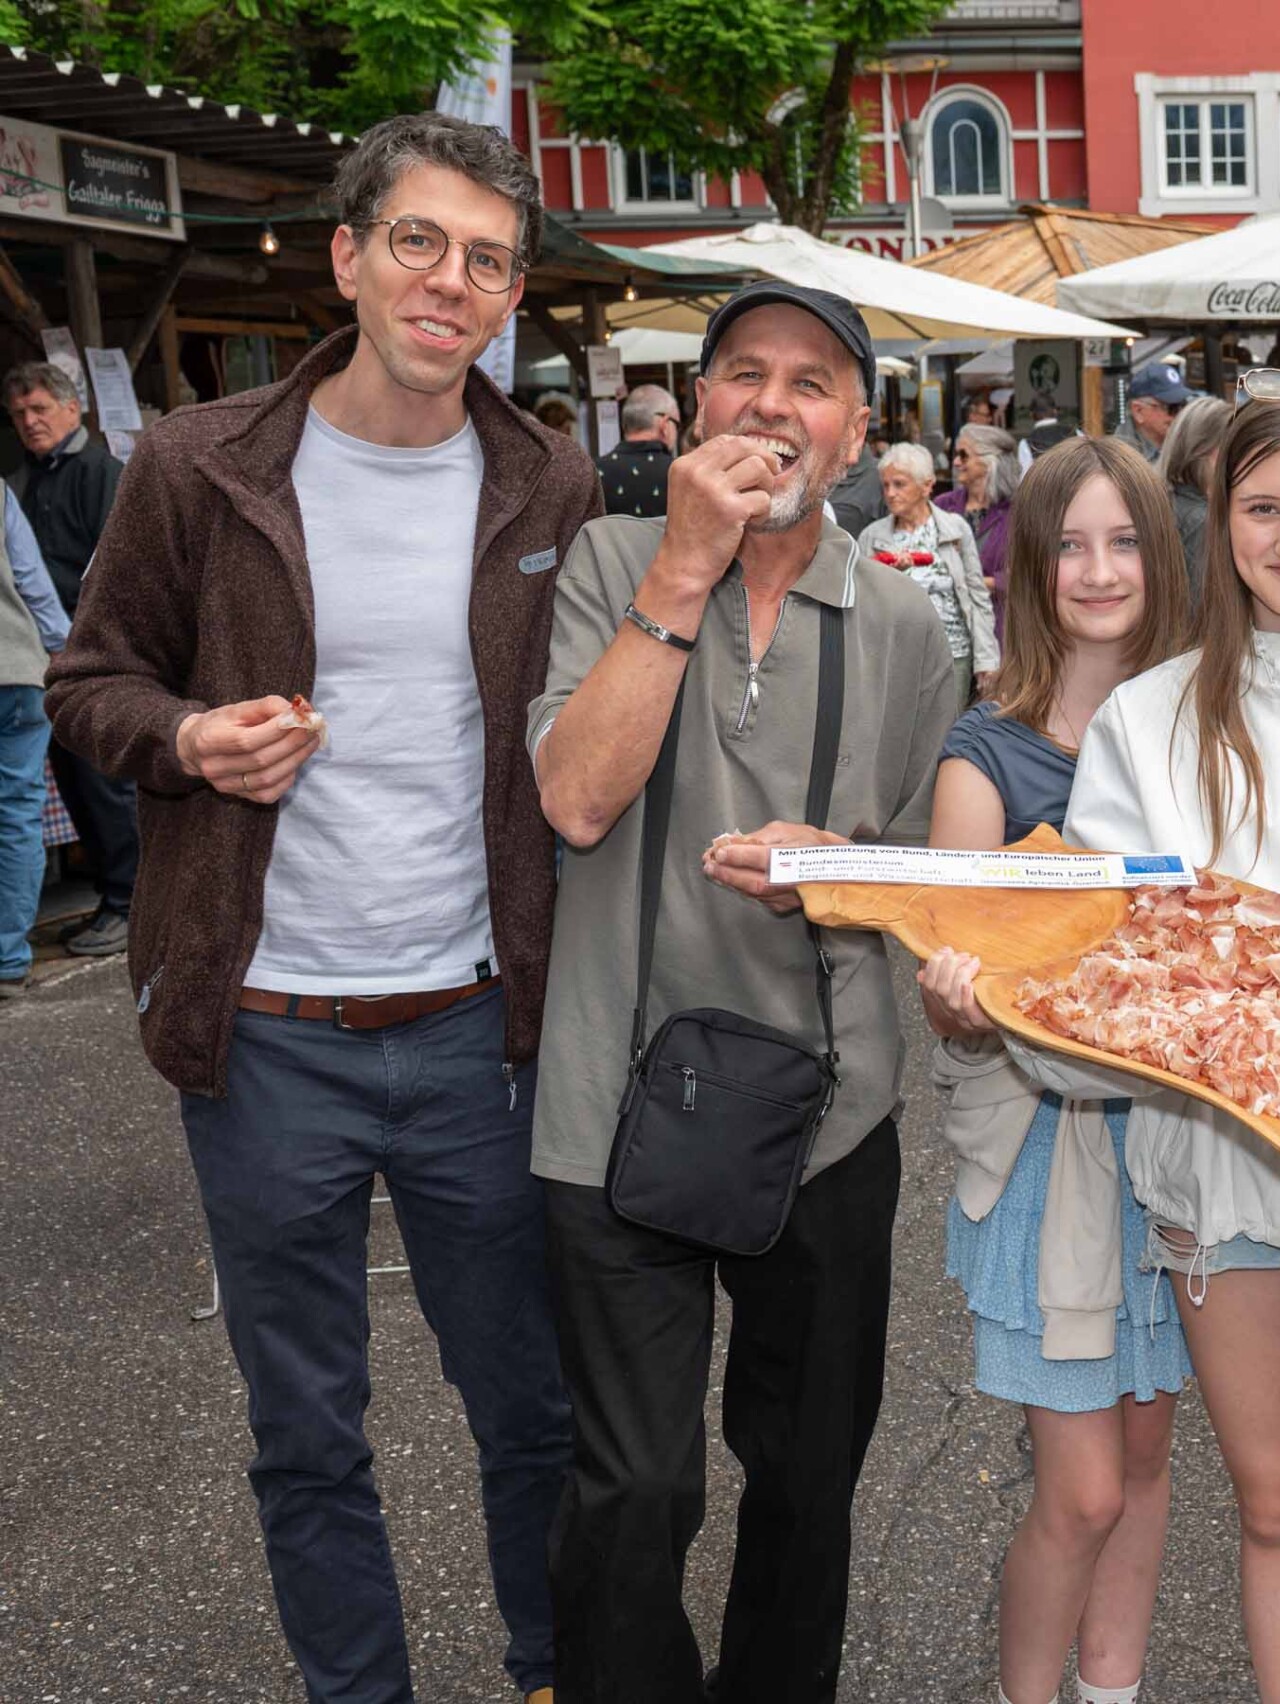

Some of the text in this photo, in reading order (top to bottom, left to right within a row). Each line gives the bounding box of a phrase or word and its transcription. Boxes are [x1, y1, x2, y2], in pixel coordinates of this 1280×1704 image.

[81, 148, 149, 179] Sagmeister's
[68, 179, 122, 209] Gailtaler
[778, 849, 797, 857] Mit
[800, 847, 877, 856] Unterstützung
[1025, 868, 1063, 877] leben
[1068, 869, 1101, 878] Land
